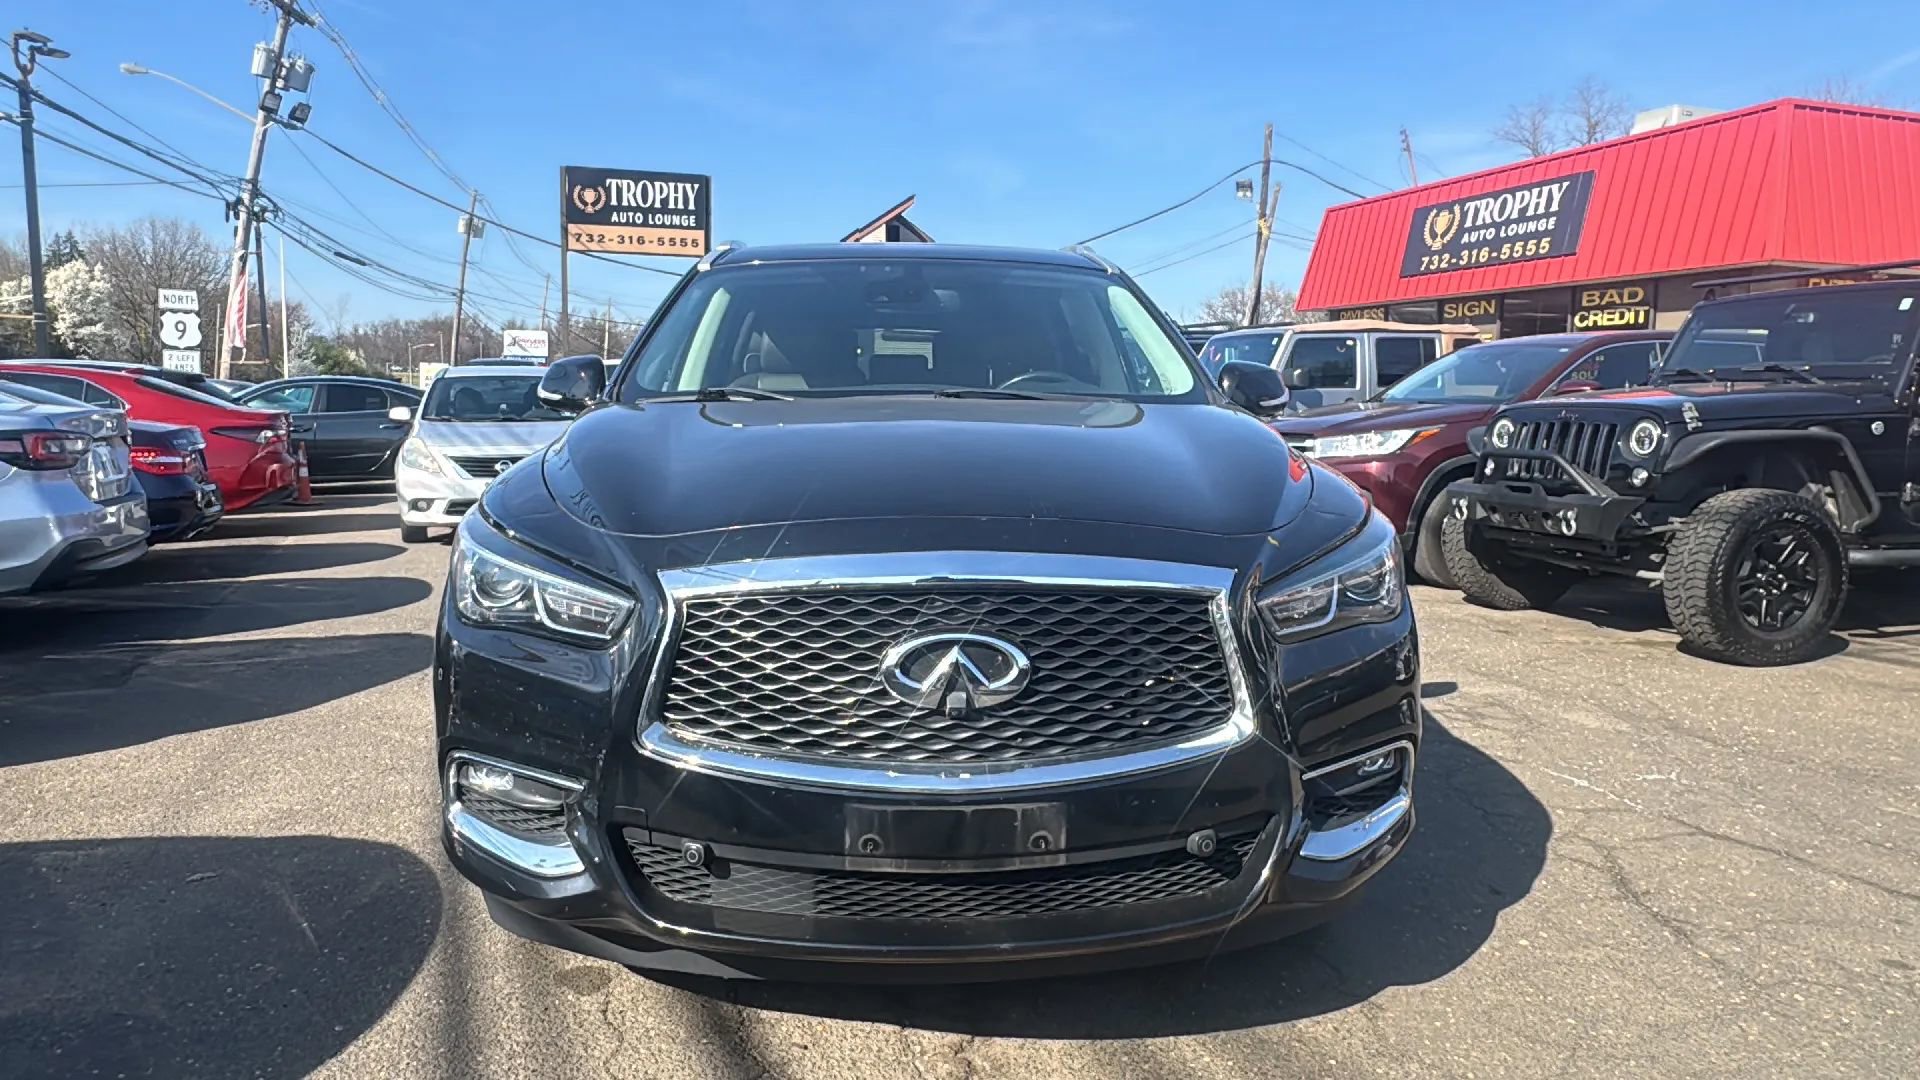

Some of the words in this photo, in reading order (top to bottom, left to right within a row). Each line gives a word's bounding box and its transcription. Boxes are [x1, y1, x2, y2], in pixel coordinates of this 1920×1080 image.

[605, 178, 700, 210] TROPHY
[1463, 181, 1570, 229] TROPHY
[611, 212, 643, 224] AUTO
[648, 213, 696, 227] LOUNGE
[573, 232, 700, 248] 732-316-5555
[1461, 227, 1496, 245] AUTO
[1499, 216, 1556, 238] LOUNGE
[1419, 237, 1551, 271] 732-316-5555
[163, 294, 197, 305] NORTH
[1582, 287, 1645, 307] BAD
[1443, 299, 1496, 319] SIGN
[1574, 306, 1650, 328] CREDIT
[174, 320, 187, 340] 9
[168, 353, 173, 361] 2
